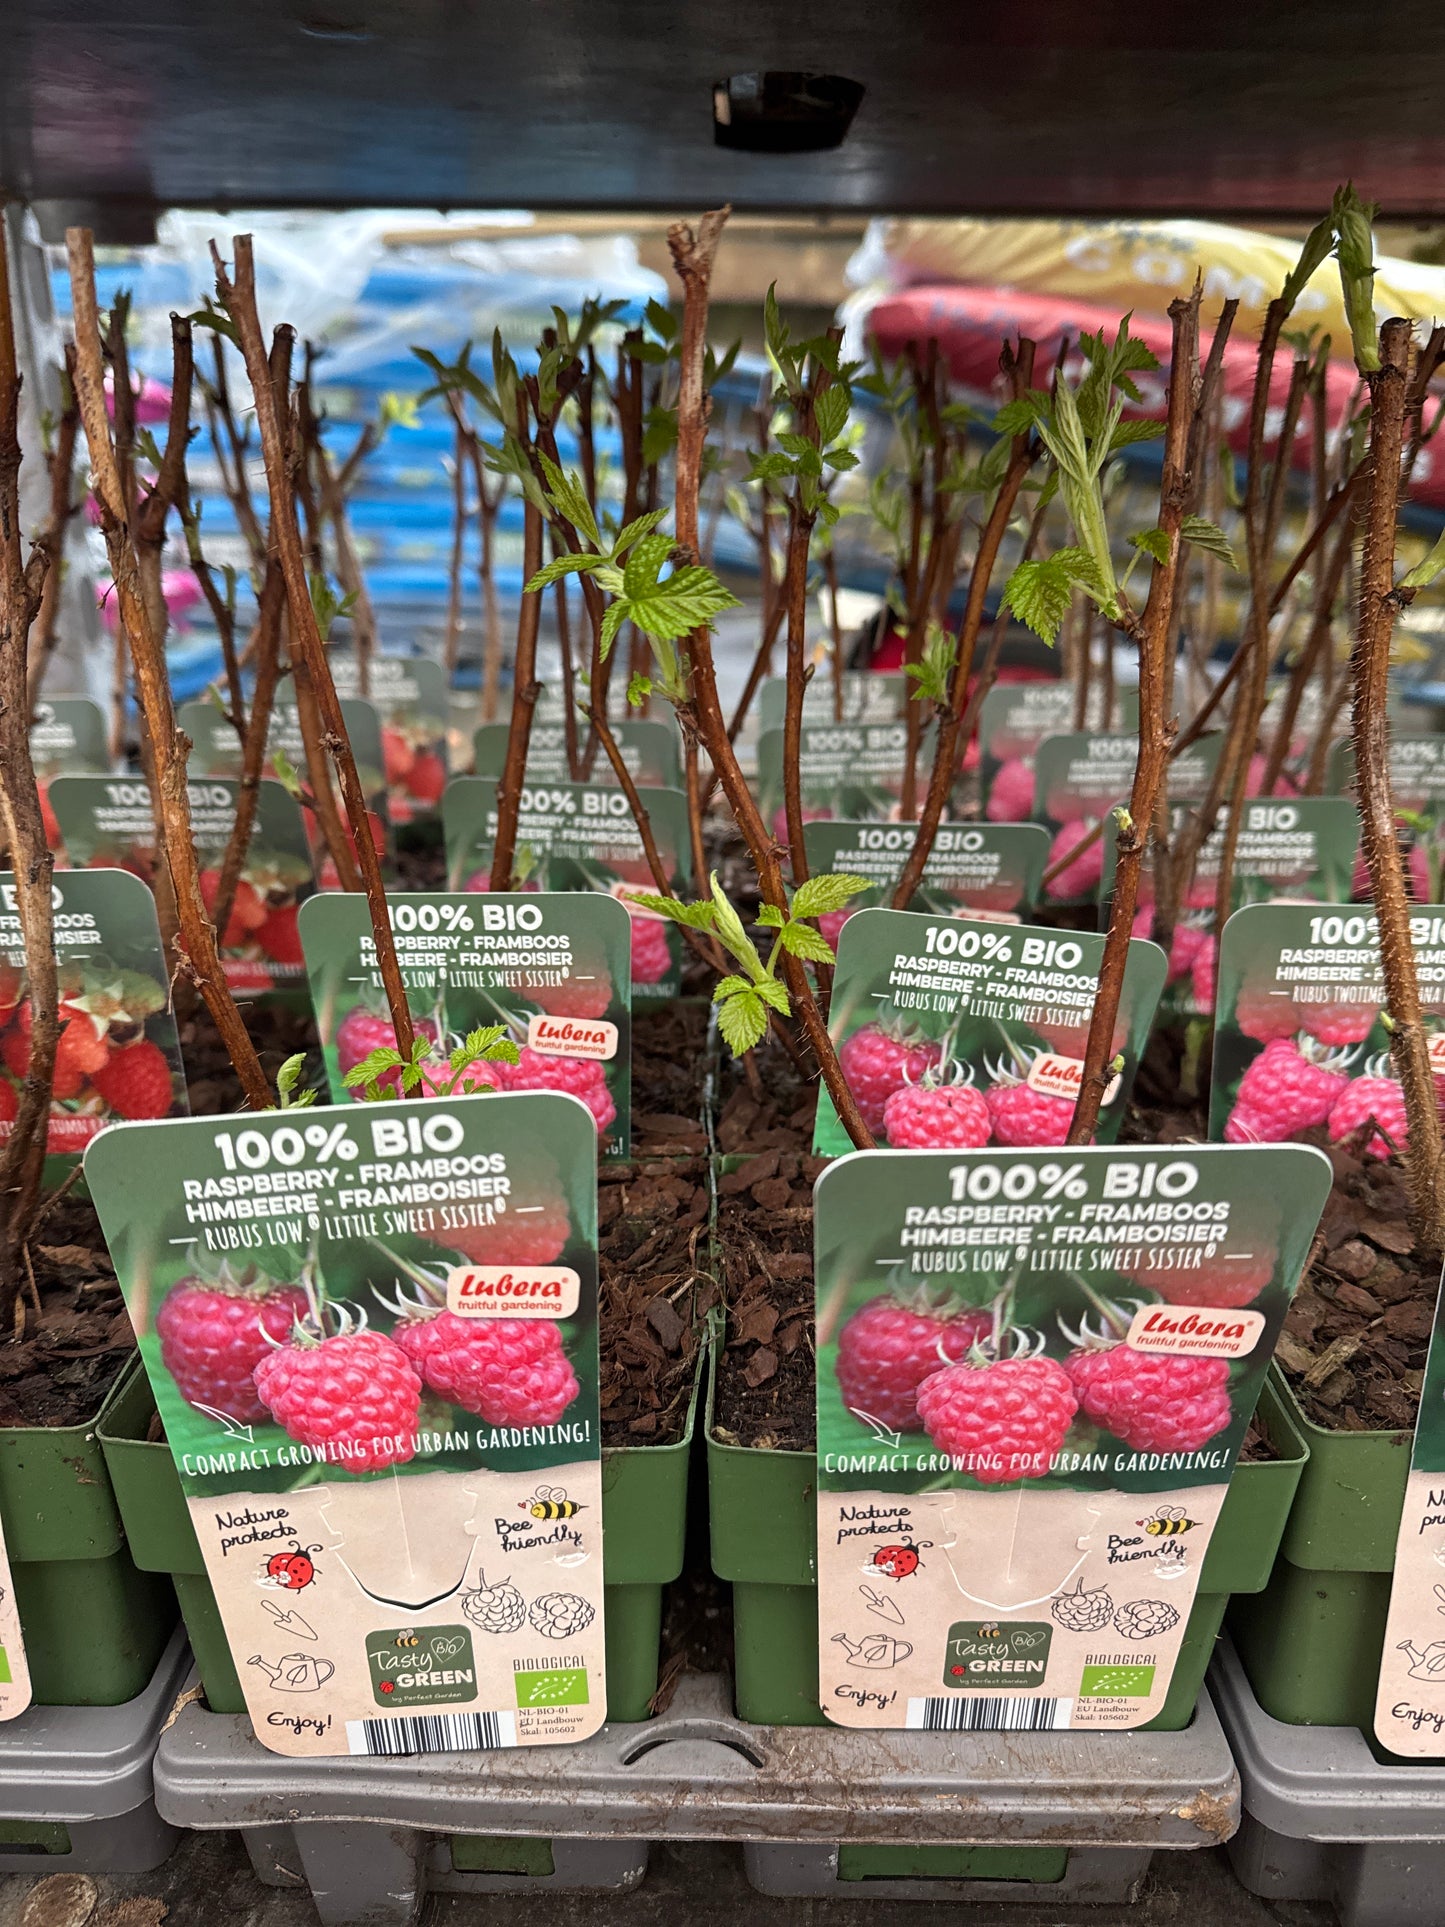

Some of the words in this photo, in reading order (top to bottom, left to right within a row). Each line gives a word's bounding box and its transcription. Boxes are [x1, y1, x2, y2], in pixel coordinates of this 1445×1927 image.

[104, 784, 153, 806] 100
[519, 788, 577, 814] 00%
[582, 792, 630, 816] BIO
[487, 812, 566, 828] RPBERRY
[1248, 806, 1298, 831] BIO
[935, 831, 984, 851] BIO
[923, 864, 999, 876] AMBOISIER
[0, 913, 96, 930] FROOS
[482, 903, 544, 931] BIO
[1410, 917, 1445, 945] BI
[360, 935, 461, 951] RPBERRY
[474, 934, 570, 950] FRAMBOOS
[925, 926, 1012, 963] 100%
[1020, 937, 1083, 970] BIO
[360, 951, 448, 967] HIBEERE
[459, 951, 573, 967] FRAMBOISIER
[1280, 948, 1384, 964] RASPBERRY
[372, 970, 409, 988] RUS
[450, 970, 483, 988] LITTLE
[489, 969, 523, 988] SWEET
[889, 970, 975, 995] HIMBEERE
[894, 954, 995, 979] RASPBERRY
[1004, 967, 1099, 992] FRAMBOOS
[1276, 966, 1364, 981] HIMBEERE
[1292, 985, 1329, 1003] RUBUS
[893, 989, 931, 1011] RUBUS
[969, 997, 1006, 1020] LITTLE
[1006, 1002, 1044, 1024] SWEET
[535, 1040, 562, 1050] fruitful
[564, 1043, 607, 1055] gardening
[1039, 1060, 1083, 1084] Lube
[214, 1122, 359, 1171] 100%
[371, 1113, 465, 1158] BIO
[183, 1167, 340, 1200] RASPBERRY
[359, 1153, 507, 1184] FRAMBOOS
[948, 1163, 1089, 1201] 100%
[1102, 1161, 1199, 1199] BIO
[185, 1192, 320, 1224] HIMBEERE
[338, 1176, 511, 1210] FRAMBOISIER
[905, 1203, 1063, 1226] RASPBERRY
[1079, 1201, 1231, 1223] FRAMBOOS
[204, 1222, 263, 1251] RUBUS
[325, 1212, 379, 1241] LITTLE
[383, 1207, 436, 1236] SWEET
[900, 1226, 1034, 1247] HIMBEERE
[1051, 1223, 1229, 1245] FRAMBOISIER
[911, 1250, 968, 1273] RUBUS
[1030, 1248, 1083, 1272] LITTLE
[1088, 1247, 1144, 1271] SWEET
[457, 1300, 498, 1311] fruitful
[501, 1300, 563, 1312] gardening
[1136, 1335, 1176, 1347] fruitful
[1178, 1339, 1241, 1352] gardening
[182, 1445, 273, 1477] COMPACT
[277, 1439, 368, 1468] GROWING
[372, 1433, 406, 1457] FOR
[412, 1429, 470, 1452] URBAN
[475, 1419, 591, 1450] GARDENING!
[824, 1452, 909, 1474] COMPACT
[916, 1451, 1004, 1472] GROWING
[1009, 1452, 1042, 1471] FOR
[1048, 1451, 1109, 1472] URBAN
[1114, 1447, 1231, 1472] GARDENING!
[214, 1506, 290, 1531] Nature
[839, 1505, 912, 1523] Nature
[494, 1518, 533, 1537] Bee
[836, 1520, 914, 1545] protects
[220, 1524, 298, 1556] protects
[501, 1528, 583, 1554] friendly
[1107, 1533, 1144, 1550] Bee
[1107, 1538, 1188, 1565] friendly
[436, 1640, 457, 1655] BIO
[949, 1638, 1009, 1662] Tasty
[1014, 1636, 1036, 1647] BIO
[369, 1650, 433, 1674] Tasty
[512, 1654, 587, 1671] BIOLOGICAL
[969, 1659, 1045, 1673] GREEN
[1084, 1653, 1158, 1665] BIOLOGICAL
[396, 1668, 474, 1688] GREEN
[959, 1678, 970, 1686] by
[971, 1677, 1000, 1685] Perfect
[391, 1696, 403, 1704] by
[404, 1693, 433, 1702] Perfect
[434, 1691, 463, 1700] Garden
[834, 1684, 899, 1711] Enjoy!
[1077, 1697, 1128, 1705] NL-BIO-01
[518, 1707, 570, 1717] NL-BIO-01
[1074, 1713, 1097, 1721] Skal:
[1097, 1713, 1130, 1721] 105602
[1076, 1705, 1091, 1713] EU
[1092, 1705, 1141, 1713] Landbouw
[1391, 1703, 1445, 1733] Enjoy
[266, 1711, 334, 1735] Enjoy!
[519, 1717, 534, 1727] EU
[536, 1715, 585, 1726] Landbouw
[520, 1727, 542, 1737] Skal:
[544, 1725, 576, 1736] 105602
